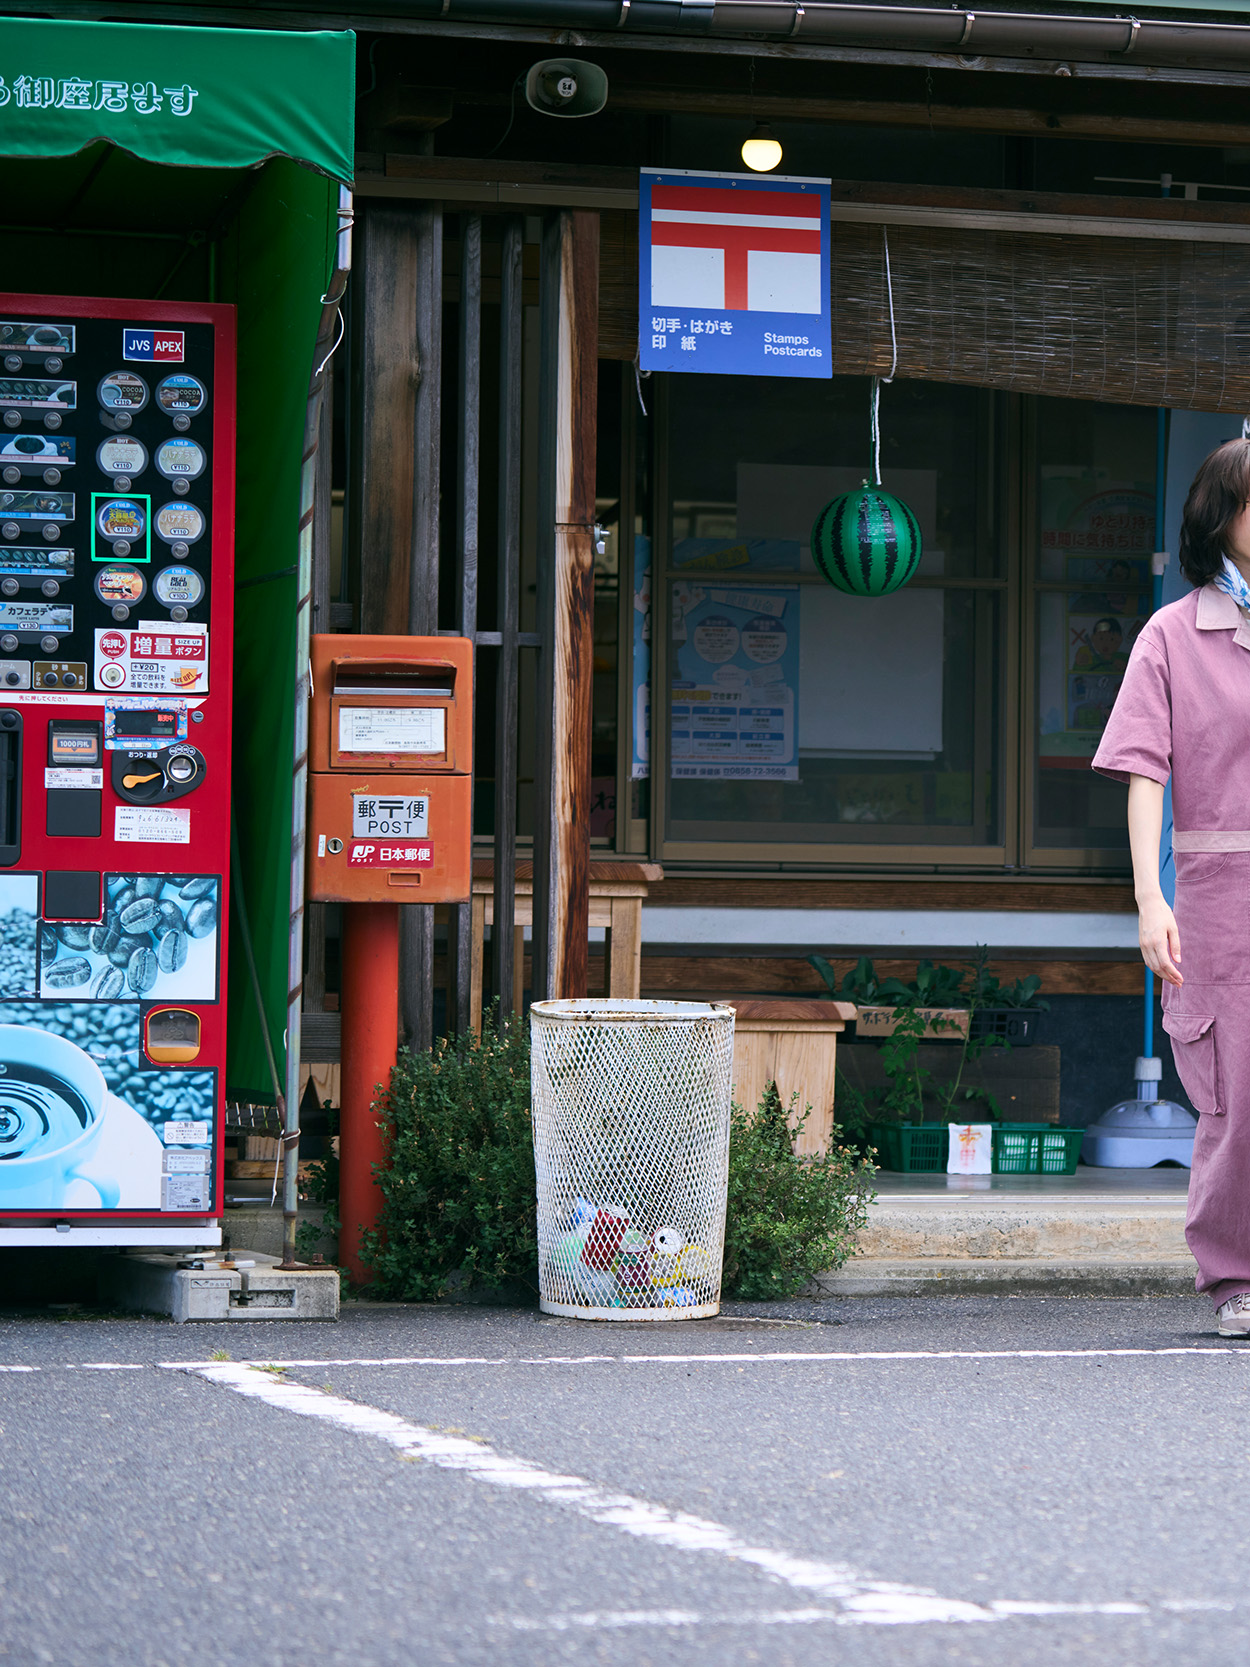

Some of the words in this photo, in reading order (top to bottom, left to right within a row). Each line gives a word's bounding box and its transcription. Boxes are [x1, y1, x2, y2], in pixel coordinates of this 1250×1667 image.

[652, 334, 667, 350] 印
[681, 336, 697, 351] 紙
[764, 332, 809, 346] Stamps
[129, 340, 150, 352] JVS
[155, 341, 182, 353] APEX
[764, 345, 823, 358] Postcards
[7, 607, 48, 616] カフェラテ
[102, 638, 126, 649] 先押し
[133, 636, 173, 656] 増量
[175, 647, 202, 656] ボタン
[130, 673, 166, 681] 全ての飲料を
[18, 694, 69, 702] 先に押してください
[59, 740, 90, 748] 1000円札
[368, 820, 413, 834] POST
[379, 847, 431, 862] 日本郵便
